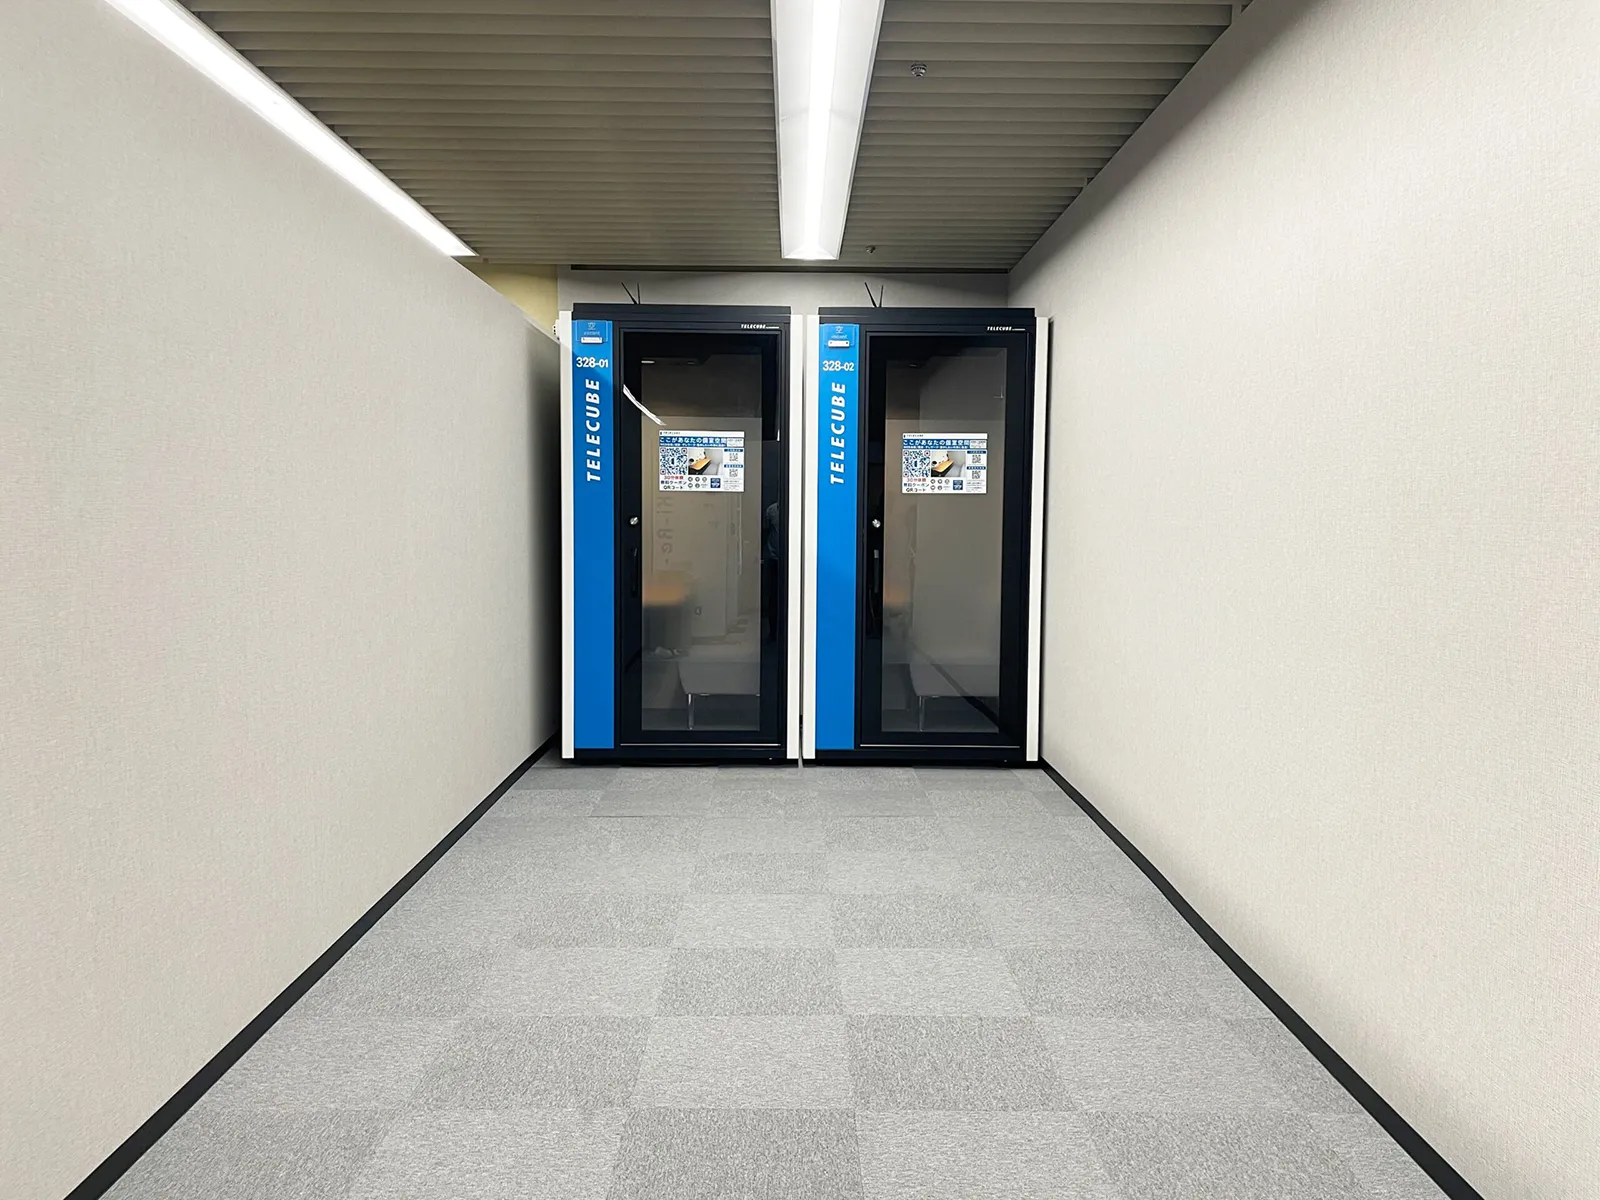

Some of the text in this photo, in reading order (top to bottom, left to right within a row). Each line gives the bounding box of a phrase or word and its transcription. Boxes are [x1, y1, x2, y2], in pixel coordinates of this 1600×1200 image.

[576, 357, 609, 369] 328-01
[822, 360, 855, 372] 328-02
[585, 379, 601, 483] TELECUBE
[830, 382, 846, 485] TELECUBE
